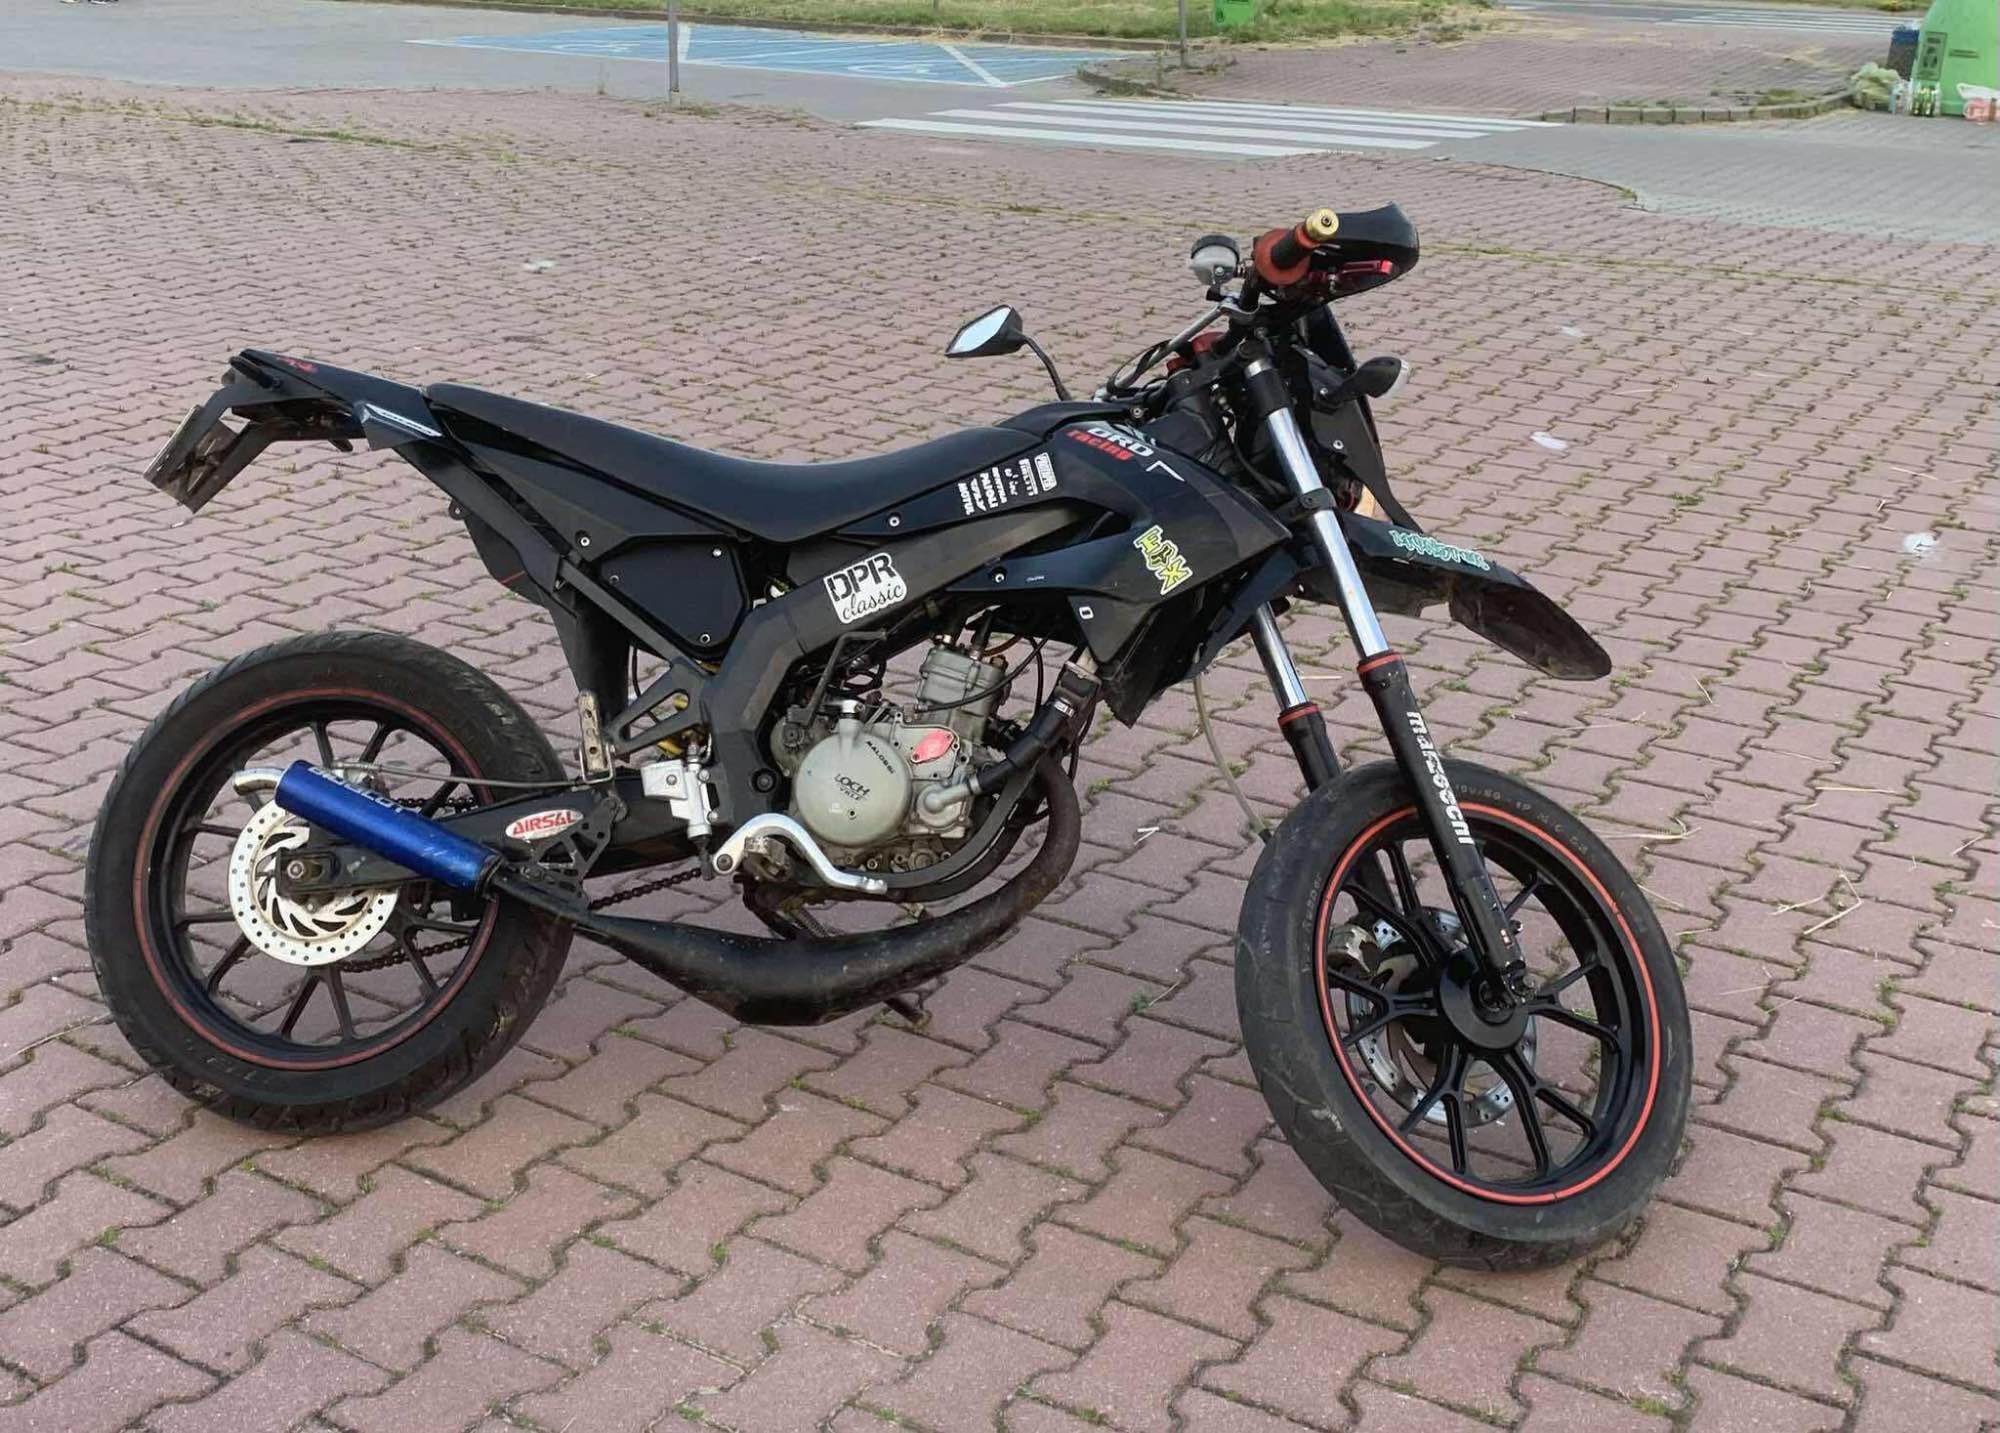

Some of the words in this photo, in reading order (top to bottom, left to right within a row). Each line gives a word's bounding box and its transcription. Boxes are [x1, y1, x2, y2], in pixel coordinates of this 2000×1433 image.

[957, 482, 975, 516] MOTUL
[826, 555, 897, 602] DPR
[842, 582, 904, 620] classic
[513, 810, 577, 836] AIRSAL
